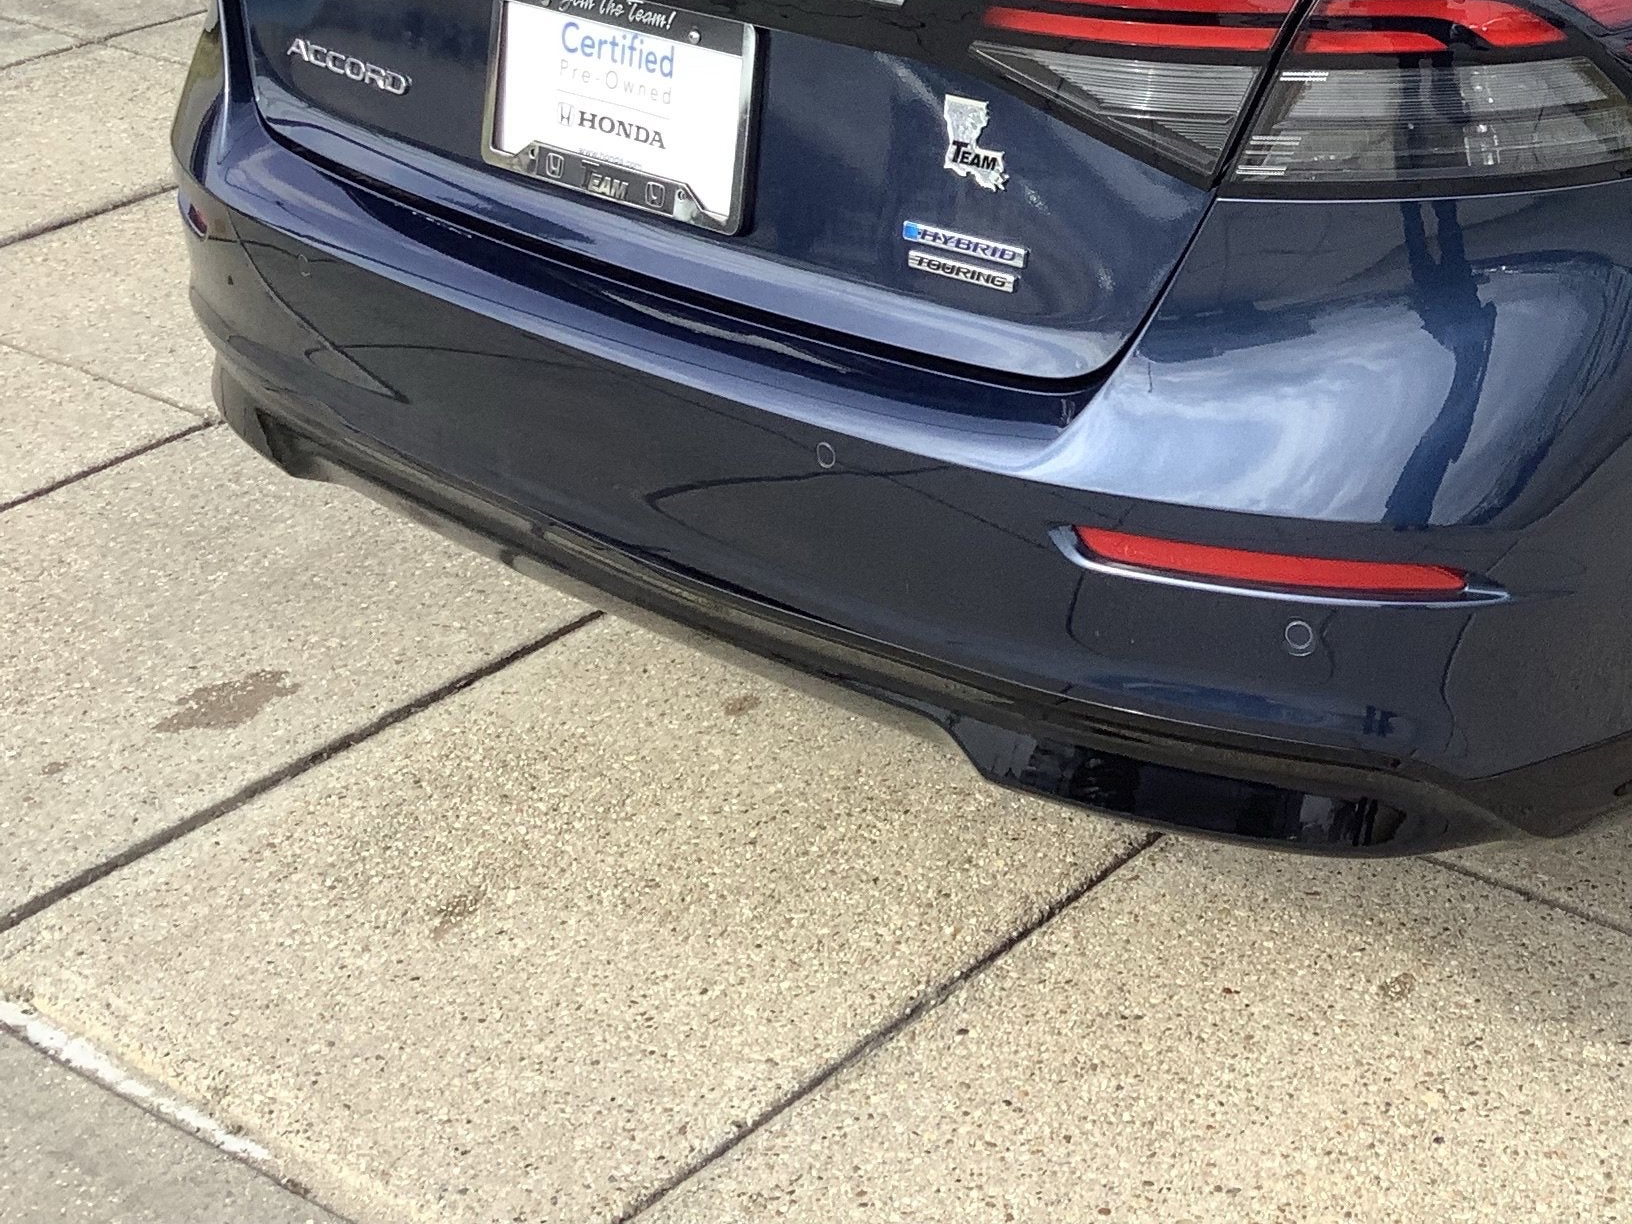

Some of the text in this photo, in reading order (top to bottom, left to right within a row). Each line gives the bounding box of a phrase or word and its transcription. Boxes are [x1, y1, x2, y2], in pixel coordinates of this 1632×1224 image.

[626, 0, 677, 30] Team!
[287, 38, 410, 95] ACCORD
[561, 22, 675, 79] Certified
[559, 59, 672, 104] Pre-Owned
[578, 110, 666, 150] HONDA
[920, 229, 1017, 262] HYBRID
[915, 255, 1006, 287] TOURING
